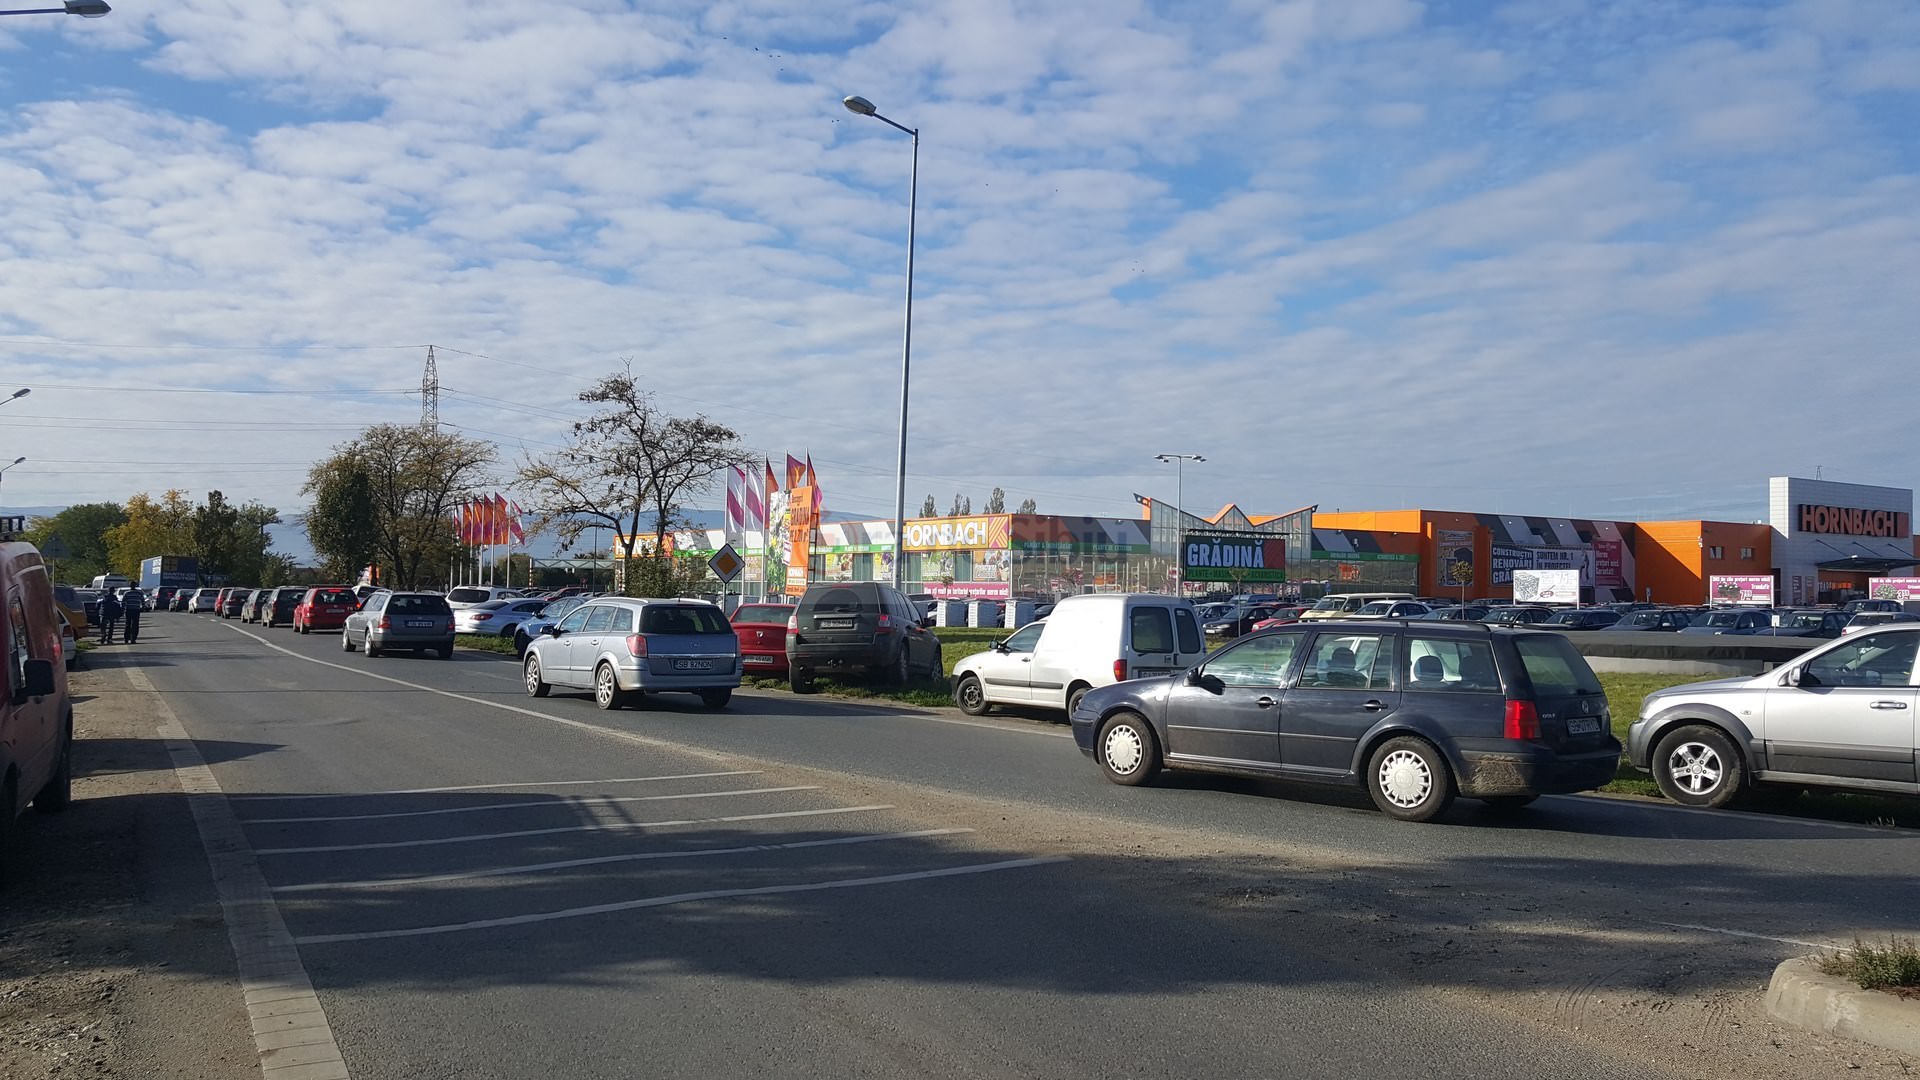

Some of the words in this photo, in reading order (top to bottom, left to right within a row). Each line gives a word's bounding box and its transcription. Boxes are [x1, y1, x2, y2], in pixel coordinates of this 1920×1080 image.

[903, 521, 987, 547] HORNBACH
[1801, 504, 1895, 537] HORNBACH
[1187, 538, 1265, 568] GRĂDINĂ
